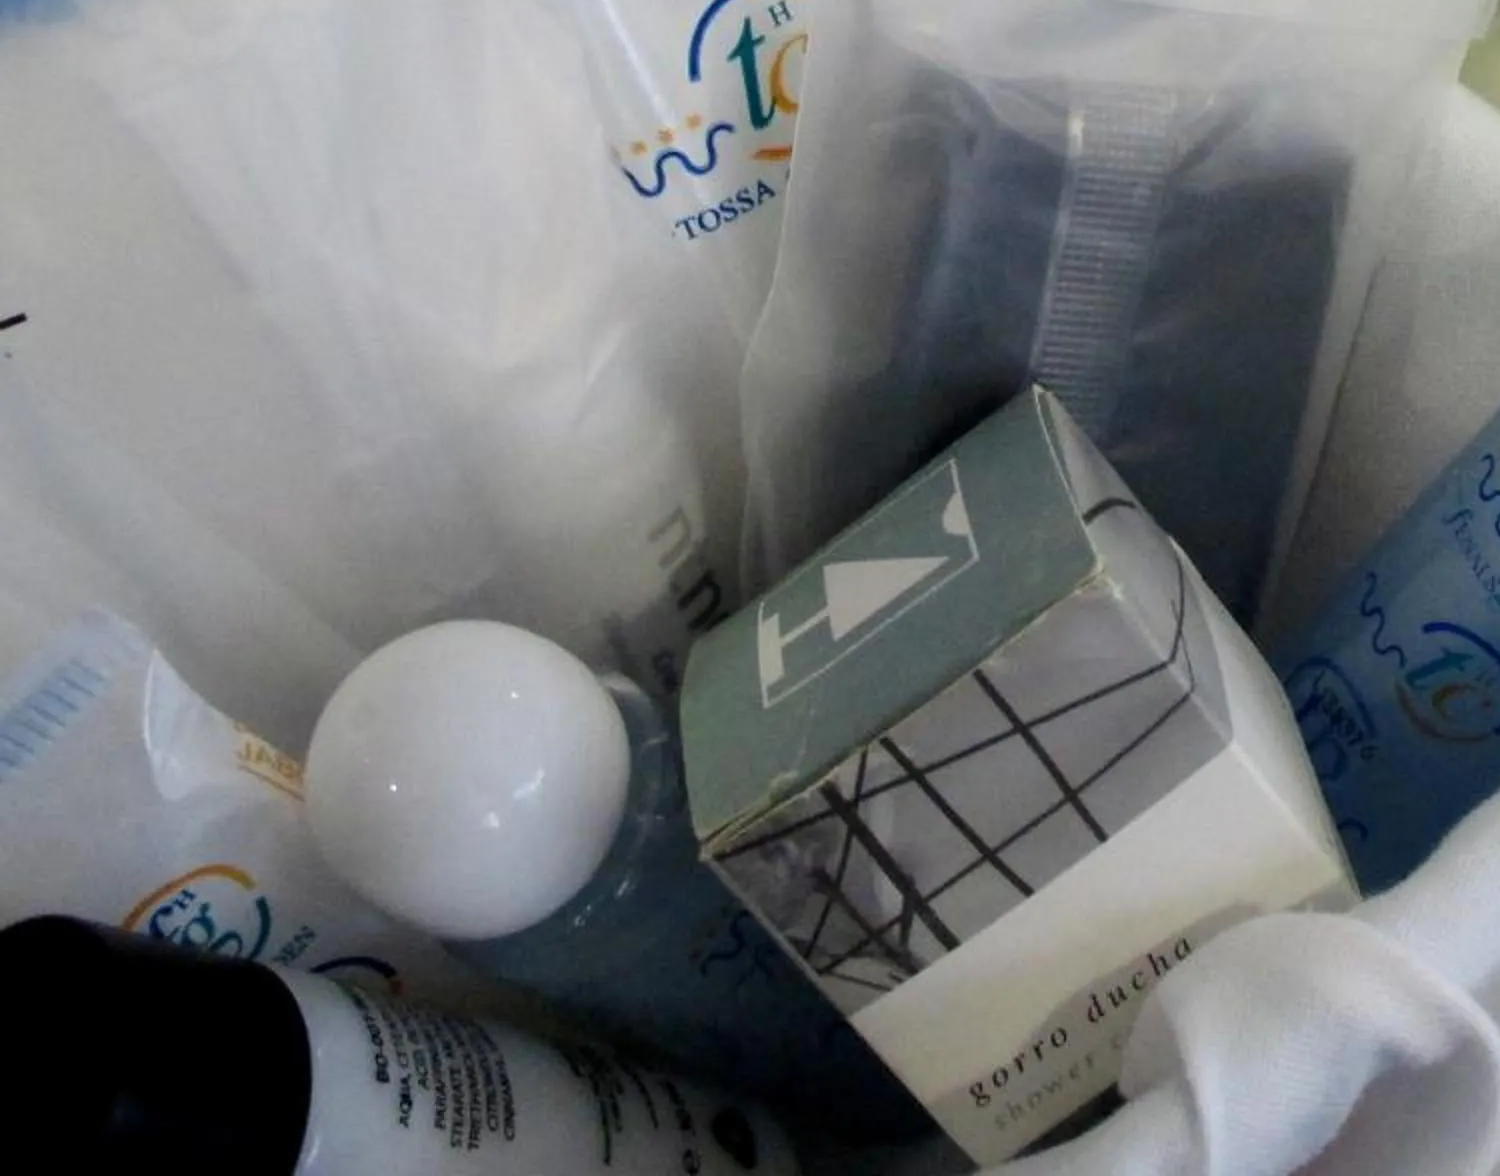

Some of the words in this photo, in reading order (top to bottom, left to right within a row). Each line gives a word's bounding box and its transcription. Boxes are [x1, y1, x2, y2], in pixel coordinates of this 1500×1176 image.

[674, 178, 777, 241] TOSSA
[968, 1026, 1069, 1109] gorro
[1086, 936, 1193, 1024] ducha
